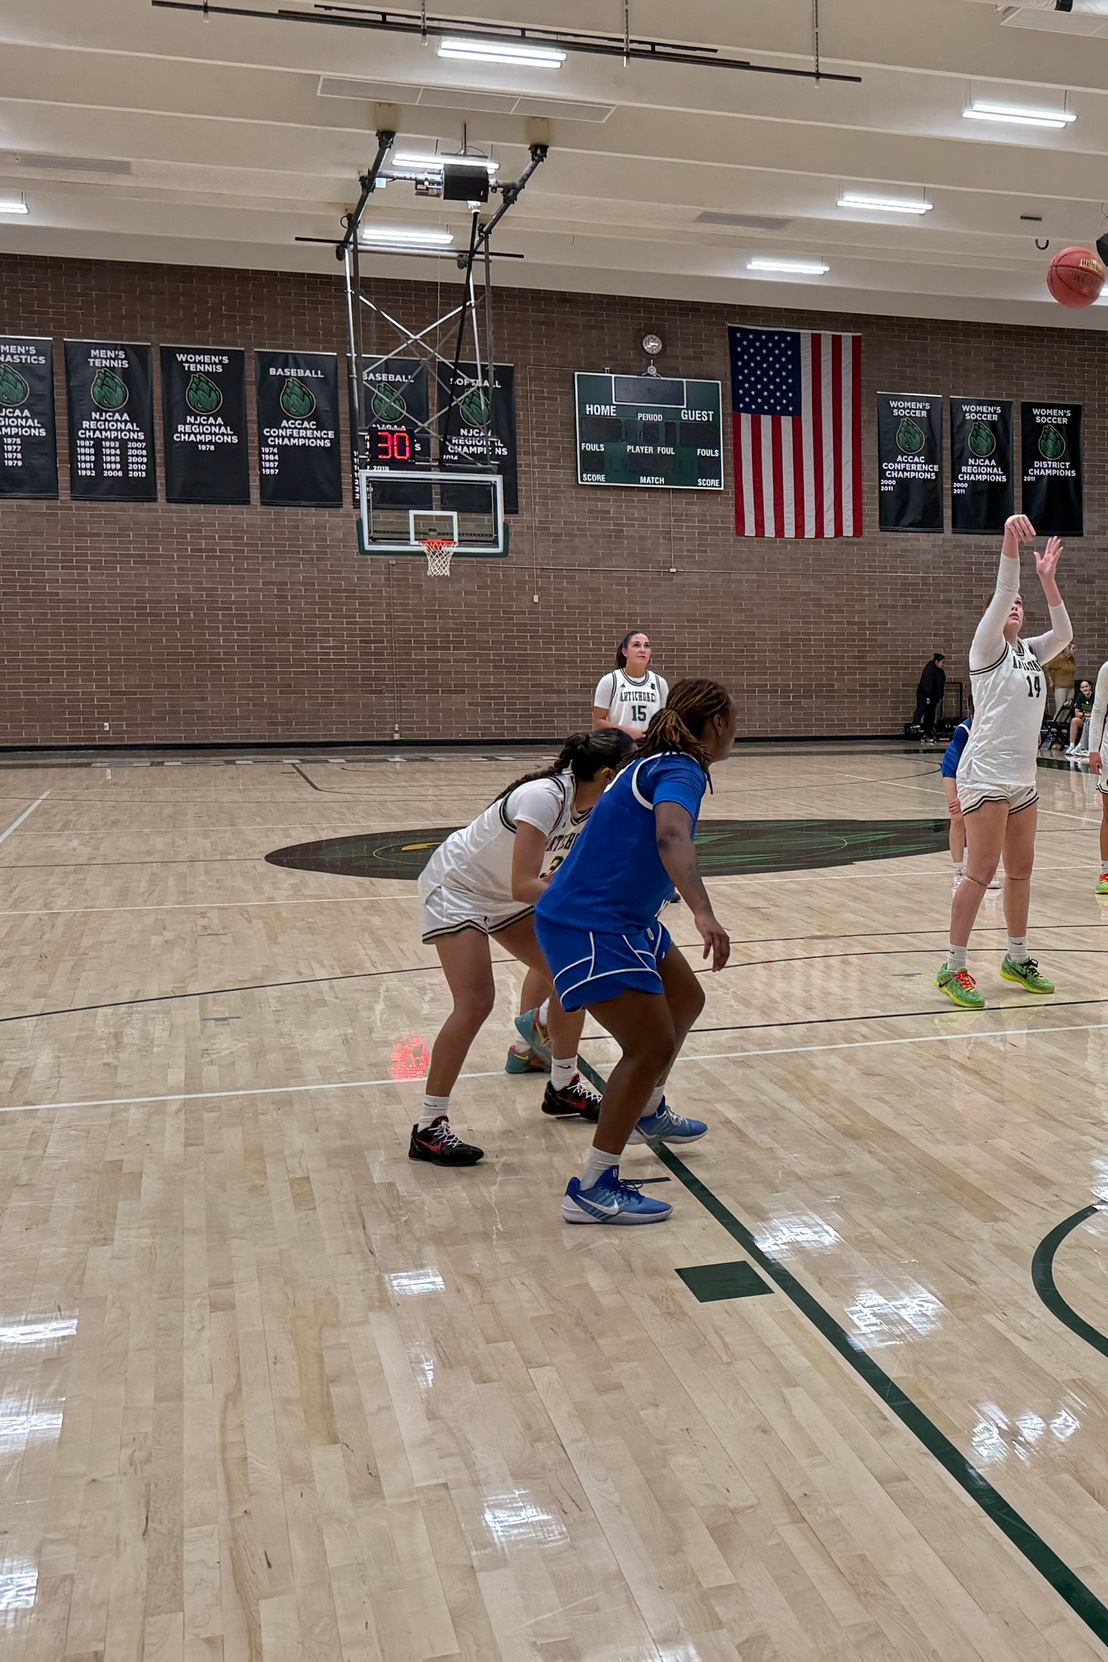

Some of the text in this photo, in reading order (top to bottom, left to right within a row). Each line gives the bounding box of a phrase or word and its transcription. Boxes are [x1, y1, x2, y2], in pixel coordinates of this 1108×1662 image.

[91, 350, 125, 358] MEN'S
[88, 359, 129, 368] TENNIS
[176, 354, 229, 364] WOMEN'S
[183, 364, 223, 372] TENNIS
[269, 367, 324, 378] BASEBALL
[890, 400, 930, 410] WOMEN'S
[962, 404, 1001, 413] WOMEN'S
[586, 404, 617, 416] HOME
[892, 409, 927, 417] SOCCER
[1032, 408, 1071, 417] WOMEN'S
[92, 412, 130, 420] NJCAA
[186, 416, 224, 425] NJCAA
[638, 413, 663, 422] PERIOD
[681, 410, 714, 422] GUEST
[965, 413, 998, 421] SOCCER
[1035, 416, 1068, 424] SOCCER
[82, 421, 140, 430] REGIONAL
[281, 419, 317, 429] ACCAC
[0, 427, 46, 437] MPIONS
[177, 425, 233, 434] REGIONAL
[263, 428, 335, 438] CONFERENCE
[78, 430, 145, 440] CHAMPIONS
[173, 434, 238, 443] CHAMPIONS
[268, 437, 331, 447] CHAMPIONS
[378, 432, 411, 460] 30
[452, 438, 504, 446] REGIOL
[581, 443, 605, 451] FOULS
[627, 445, 675, 455] PLAYER FOUL
[697, 448, 719, 457] FOULS
[897, 455, 926, 463] ACCAC
[882, 463, 939, 472] CONFERENCE
[1034, 461, 1070, 469] DISTRICT
[961, 466, 1004, 474] REGIONAL
[1028, 468, 1076, 477] CHAMPIONS
[583, 474, 606, 482] SCORE
[885, 471, 936, 479] CHAMPIONS
[958, 473, 1007, 482] CHAMPIONS
[640, 476, 665, 484] MATCH
[697, 478, 720, 487] SCORE
[631, 705, 647, 721] 15
